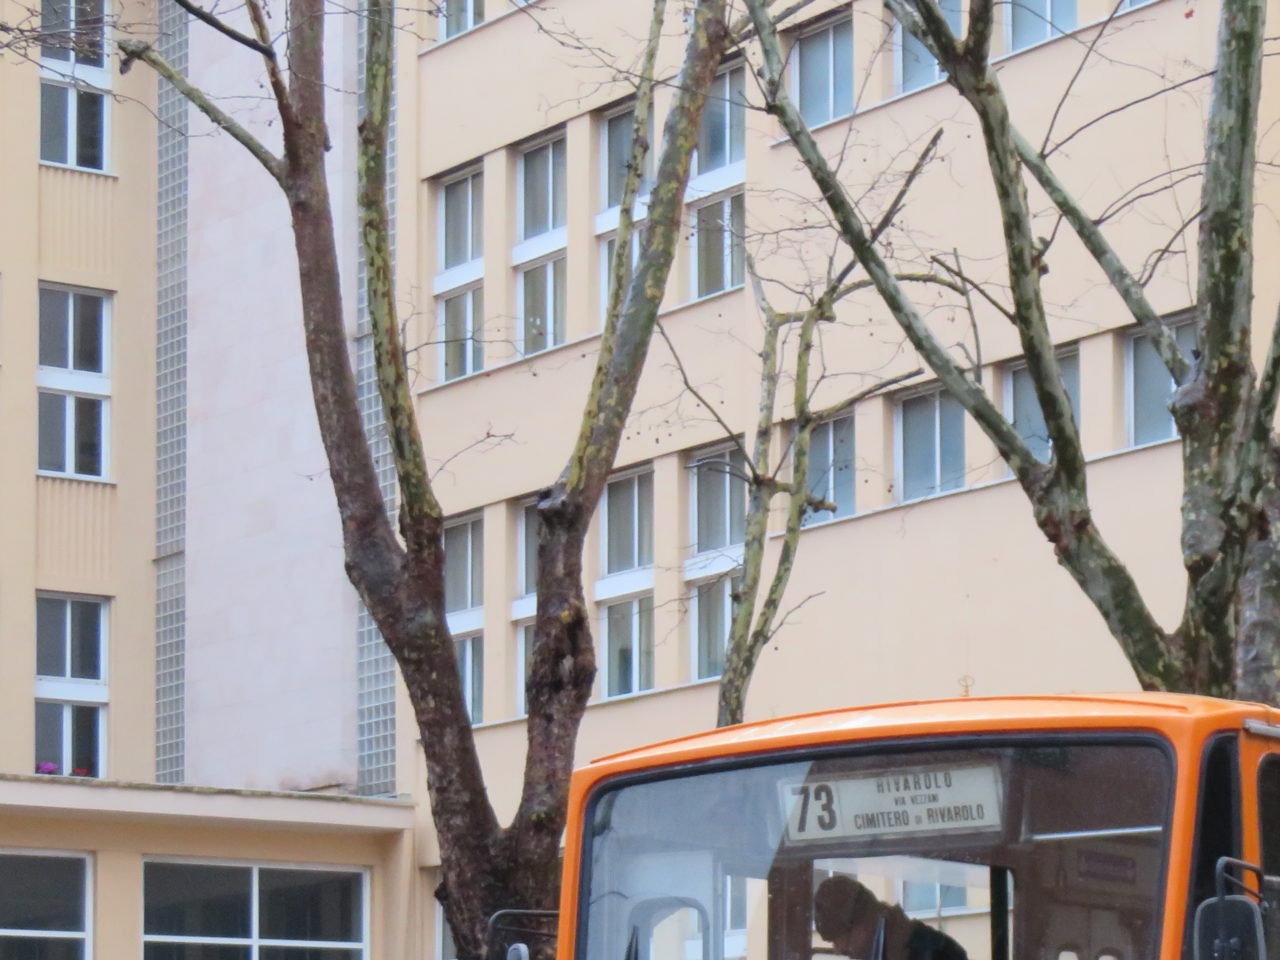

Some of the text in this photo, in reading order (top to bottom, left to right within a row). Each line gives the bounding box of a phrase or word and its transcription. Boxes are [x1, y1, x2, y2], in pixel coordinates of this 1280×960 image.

[876, 771, 953, 794] RIVAROLO
[791, 783, 838, 833] 73
[854, 809, 910, 830] CIMITERO
[927, 804, 985, 825] RIVAROLO
